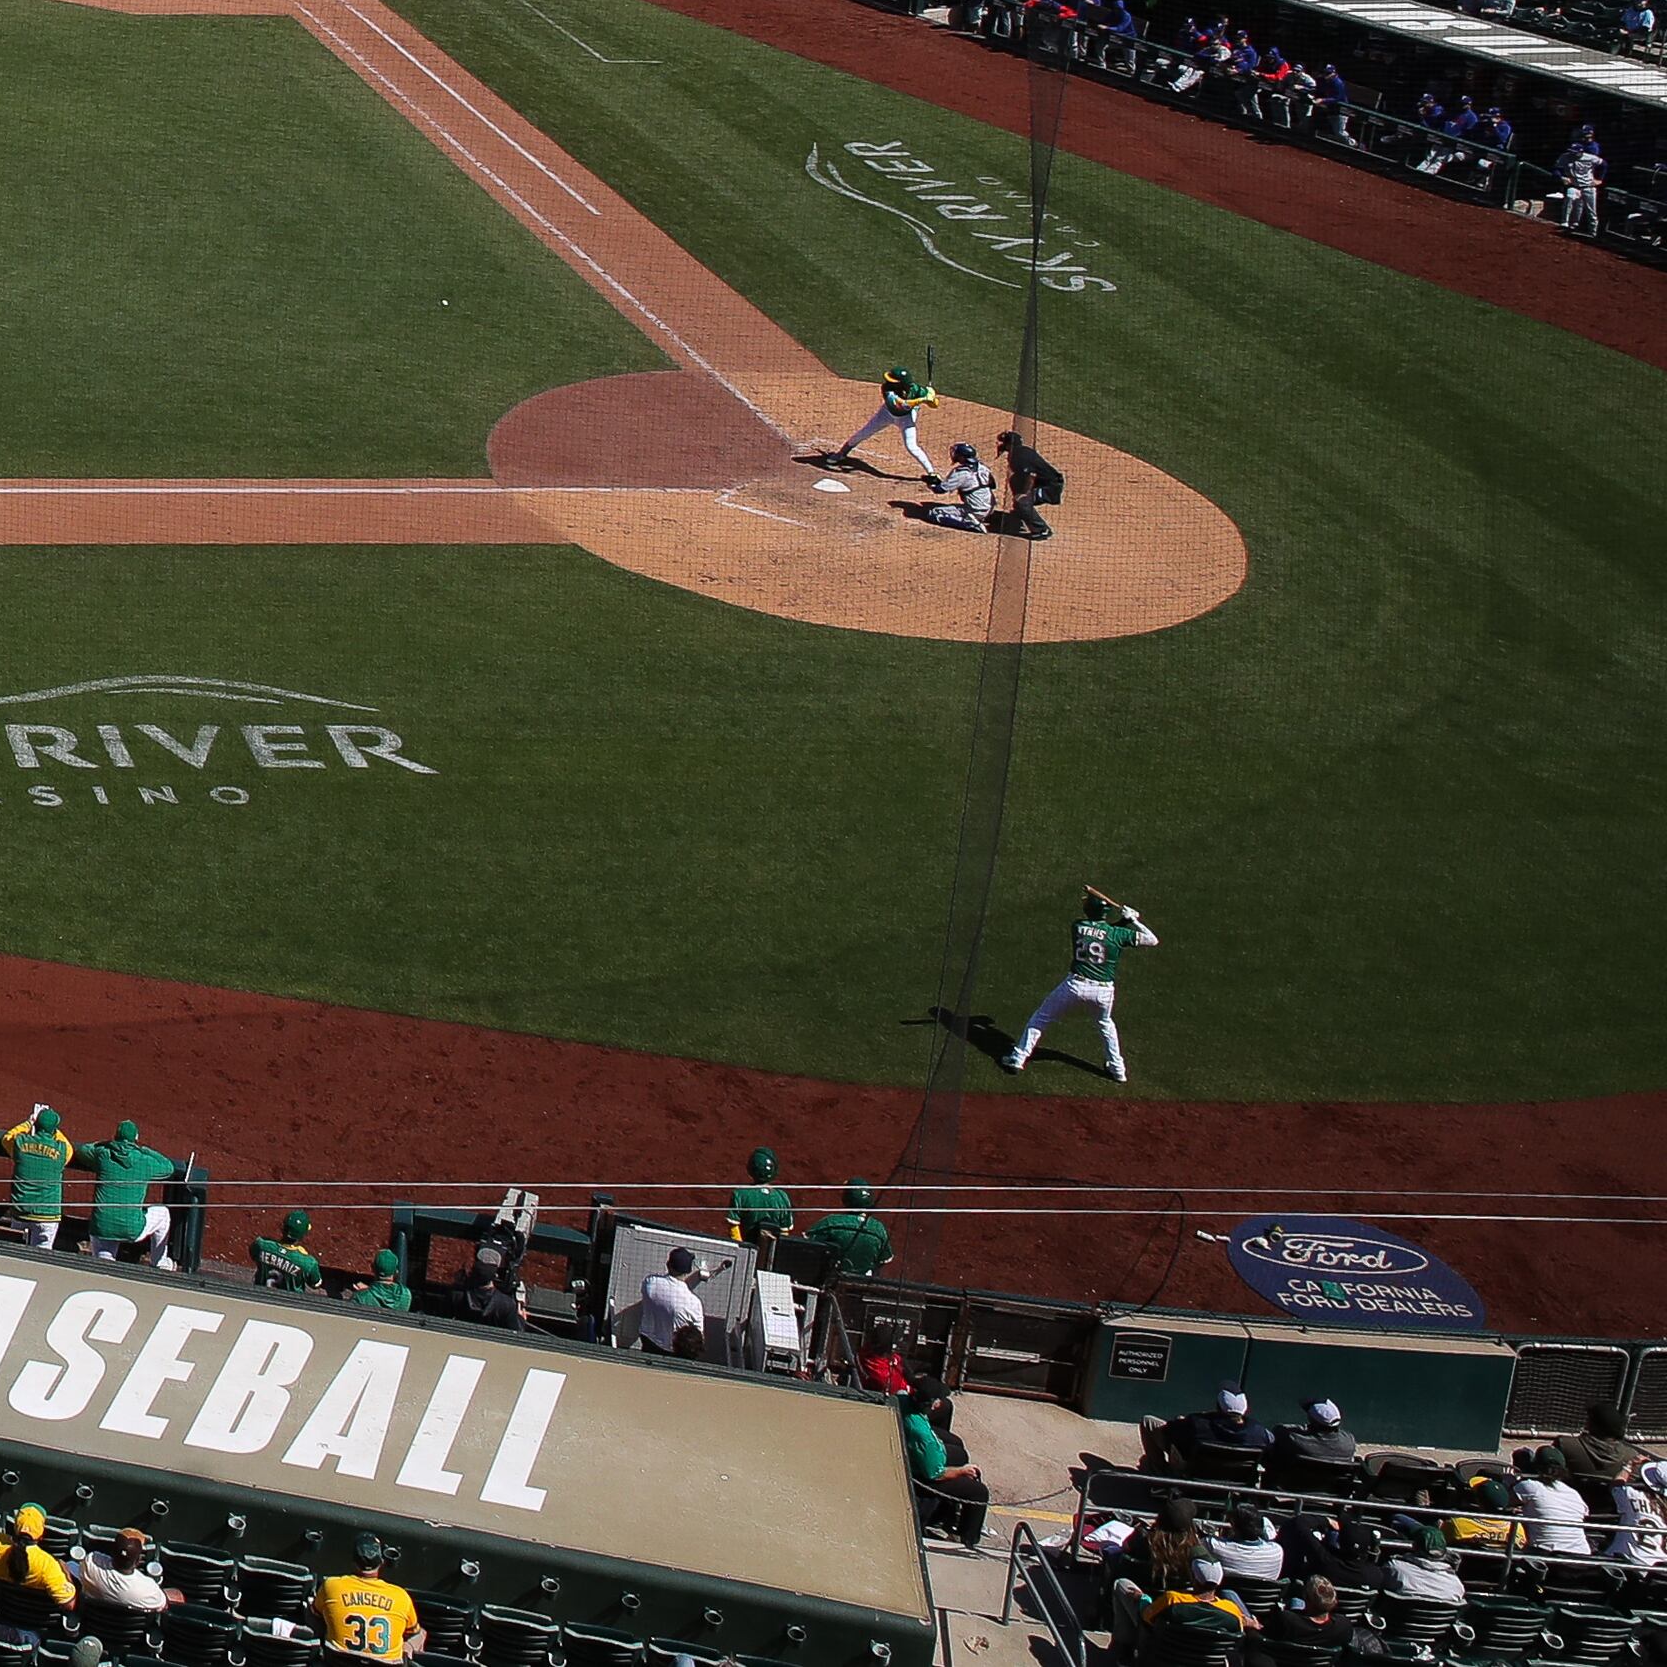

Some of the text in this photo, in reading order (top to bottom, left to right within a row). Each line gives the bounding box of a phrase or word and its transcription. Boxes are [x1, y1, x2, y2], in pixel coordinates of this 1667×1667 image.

[843, 140, 1117, 292] SKY RIVER
[4, 722, 441, 775] RIVER
[20, 1143, 60, 1160] ATHLETICS
[1282, 1236, 1392, 1270] Ford
[1288, 1279, 1441, 1301] CAFORNIA
[1277, 1292, 1472, 1318] FORD DEALERS
[1118, 1349, 1164, 1360] AUTHORIZED
[1118, 1358, 1161, 1369] PERSONNEL
[1128, 1365, 1148, 1374] ONLY
[341, 1592, 394, 1612] CANSECO
[343, 1614, 391, 1654] 33
